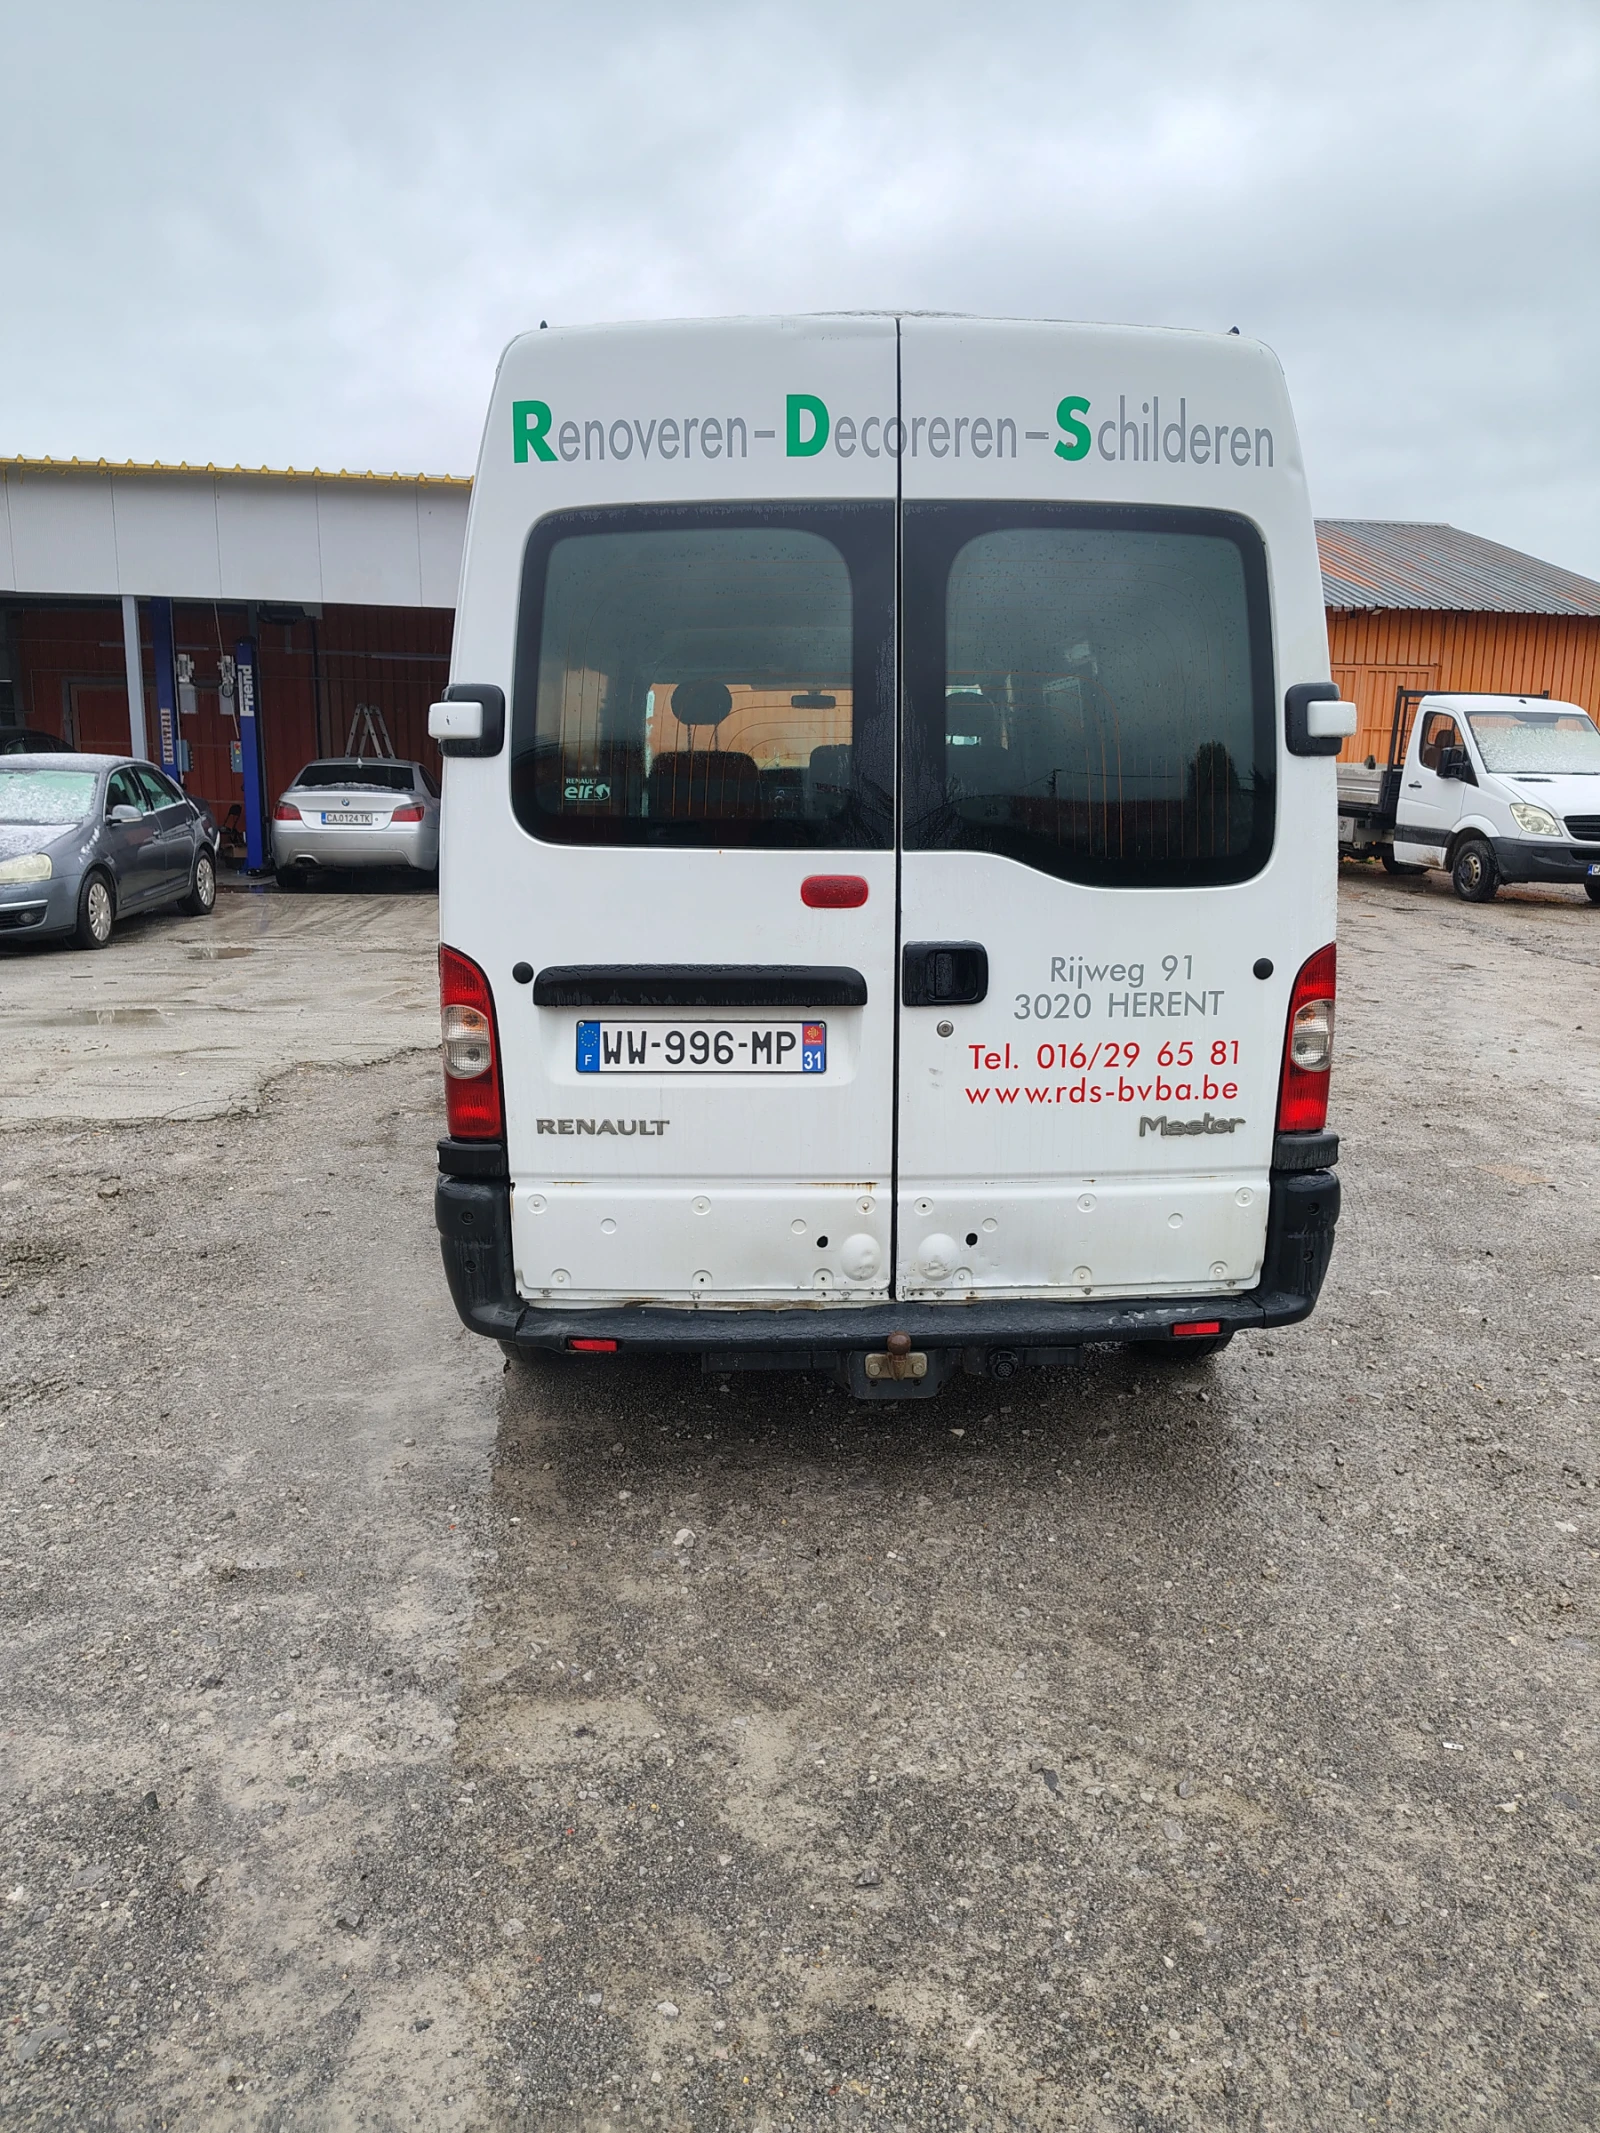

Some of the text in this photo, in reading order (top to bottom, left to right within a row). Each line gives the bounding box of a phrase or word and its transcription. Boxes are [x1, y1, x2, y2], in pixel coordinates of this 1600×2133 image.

[237, 664, 255, 717] Friend
[564, 785, 594, 799] elf
[1050, 954, 1193, 989] Rijweg 91
[1013, 990, 1225, 1020] 3020 HERENT
[584, 1054, 593, 1066] F
[602, 1030, 797, 1065] WW-996-MP
[803, 1051, 822, 1070] 31
[968, 1040, 1240, 1071] Tel. 016/29 65 81
[965, 1074, 1239, 1104] www.rds-bvba.be
[536, 1119, 670, 1136] RENAULT
[1139, 1112, 1247, 1137] Master
